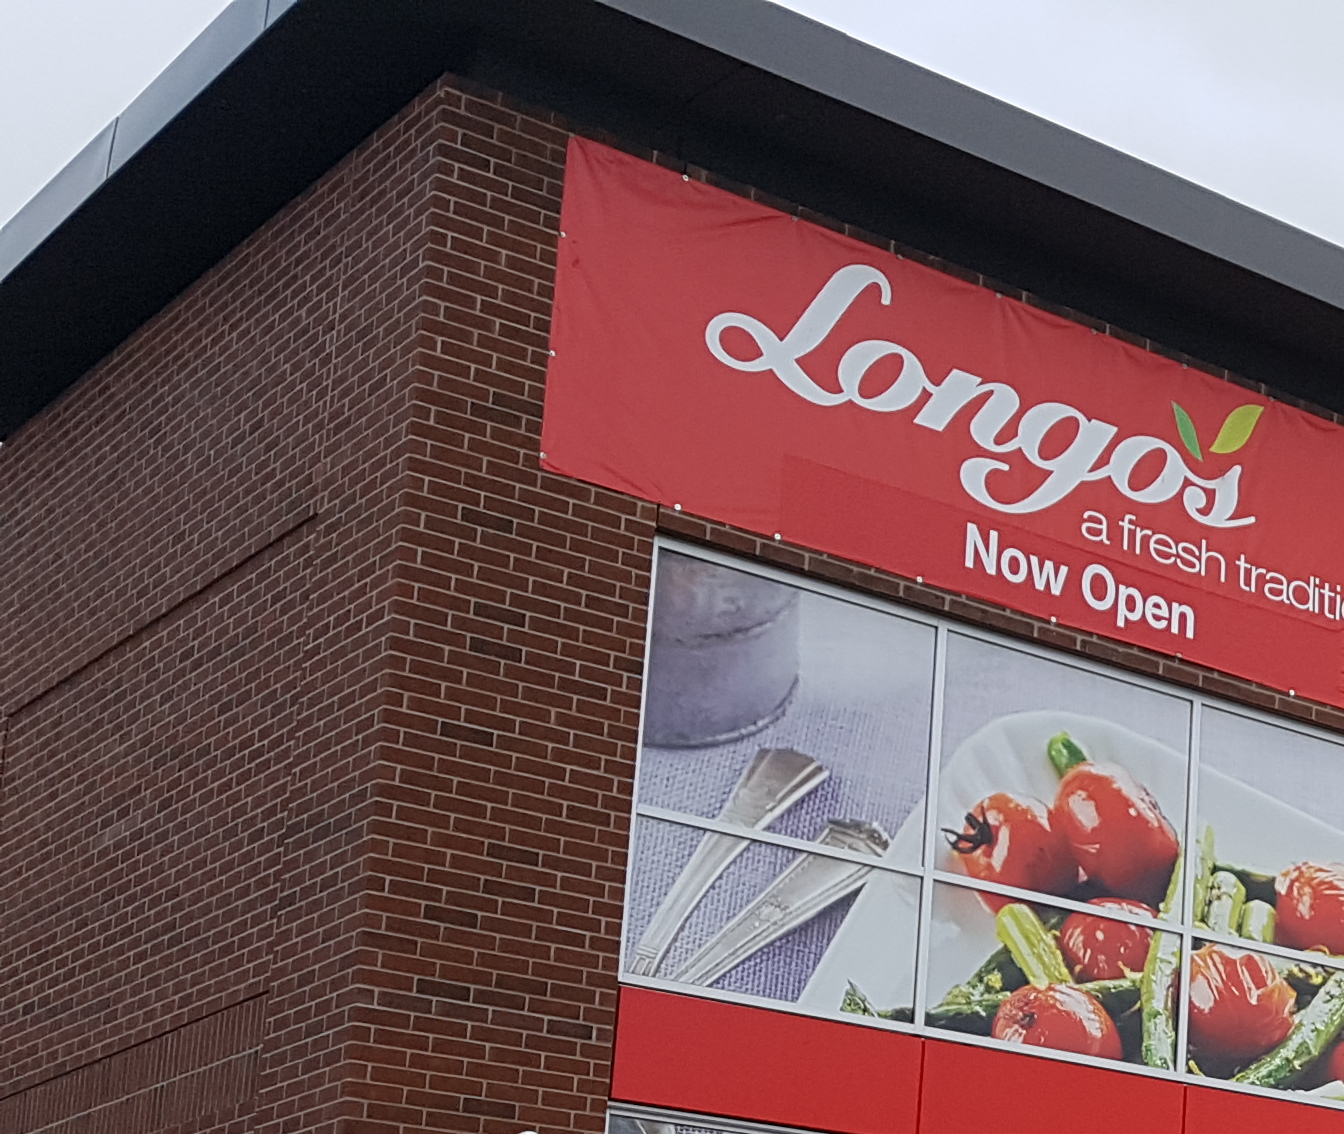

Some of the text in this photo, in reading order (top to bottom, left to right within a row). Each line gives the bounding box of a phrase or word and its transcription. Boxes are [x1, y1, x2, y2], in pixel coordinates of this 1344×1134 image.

[963, 522, 1195, 639] Now Open
[1081, 510, 1110, 545] a
[1119, 513, 1226, 583] fresh
